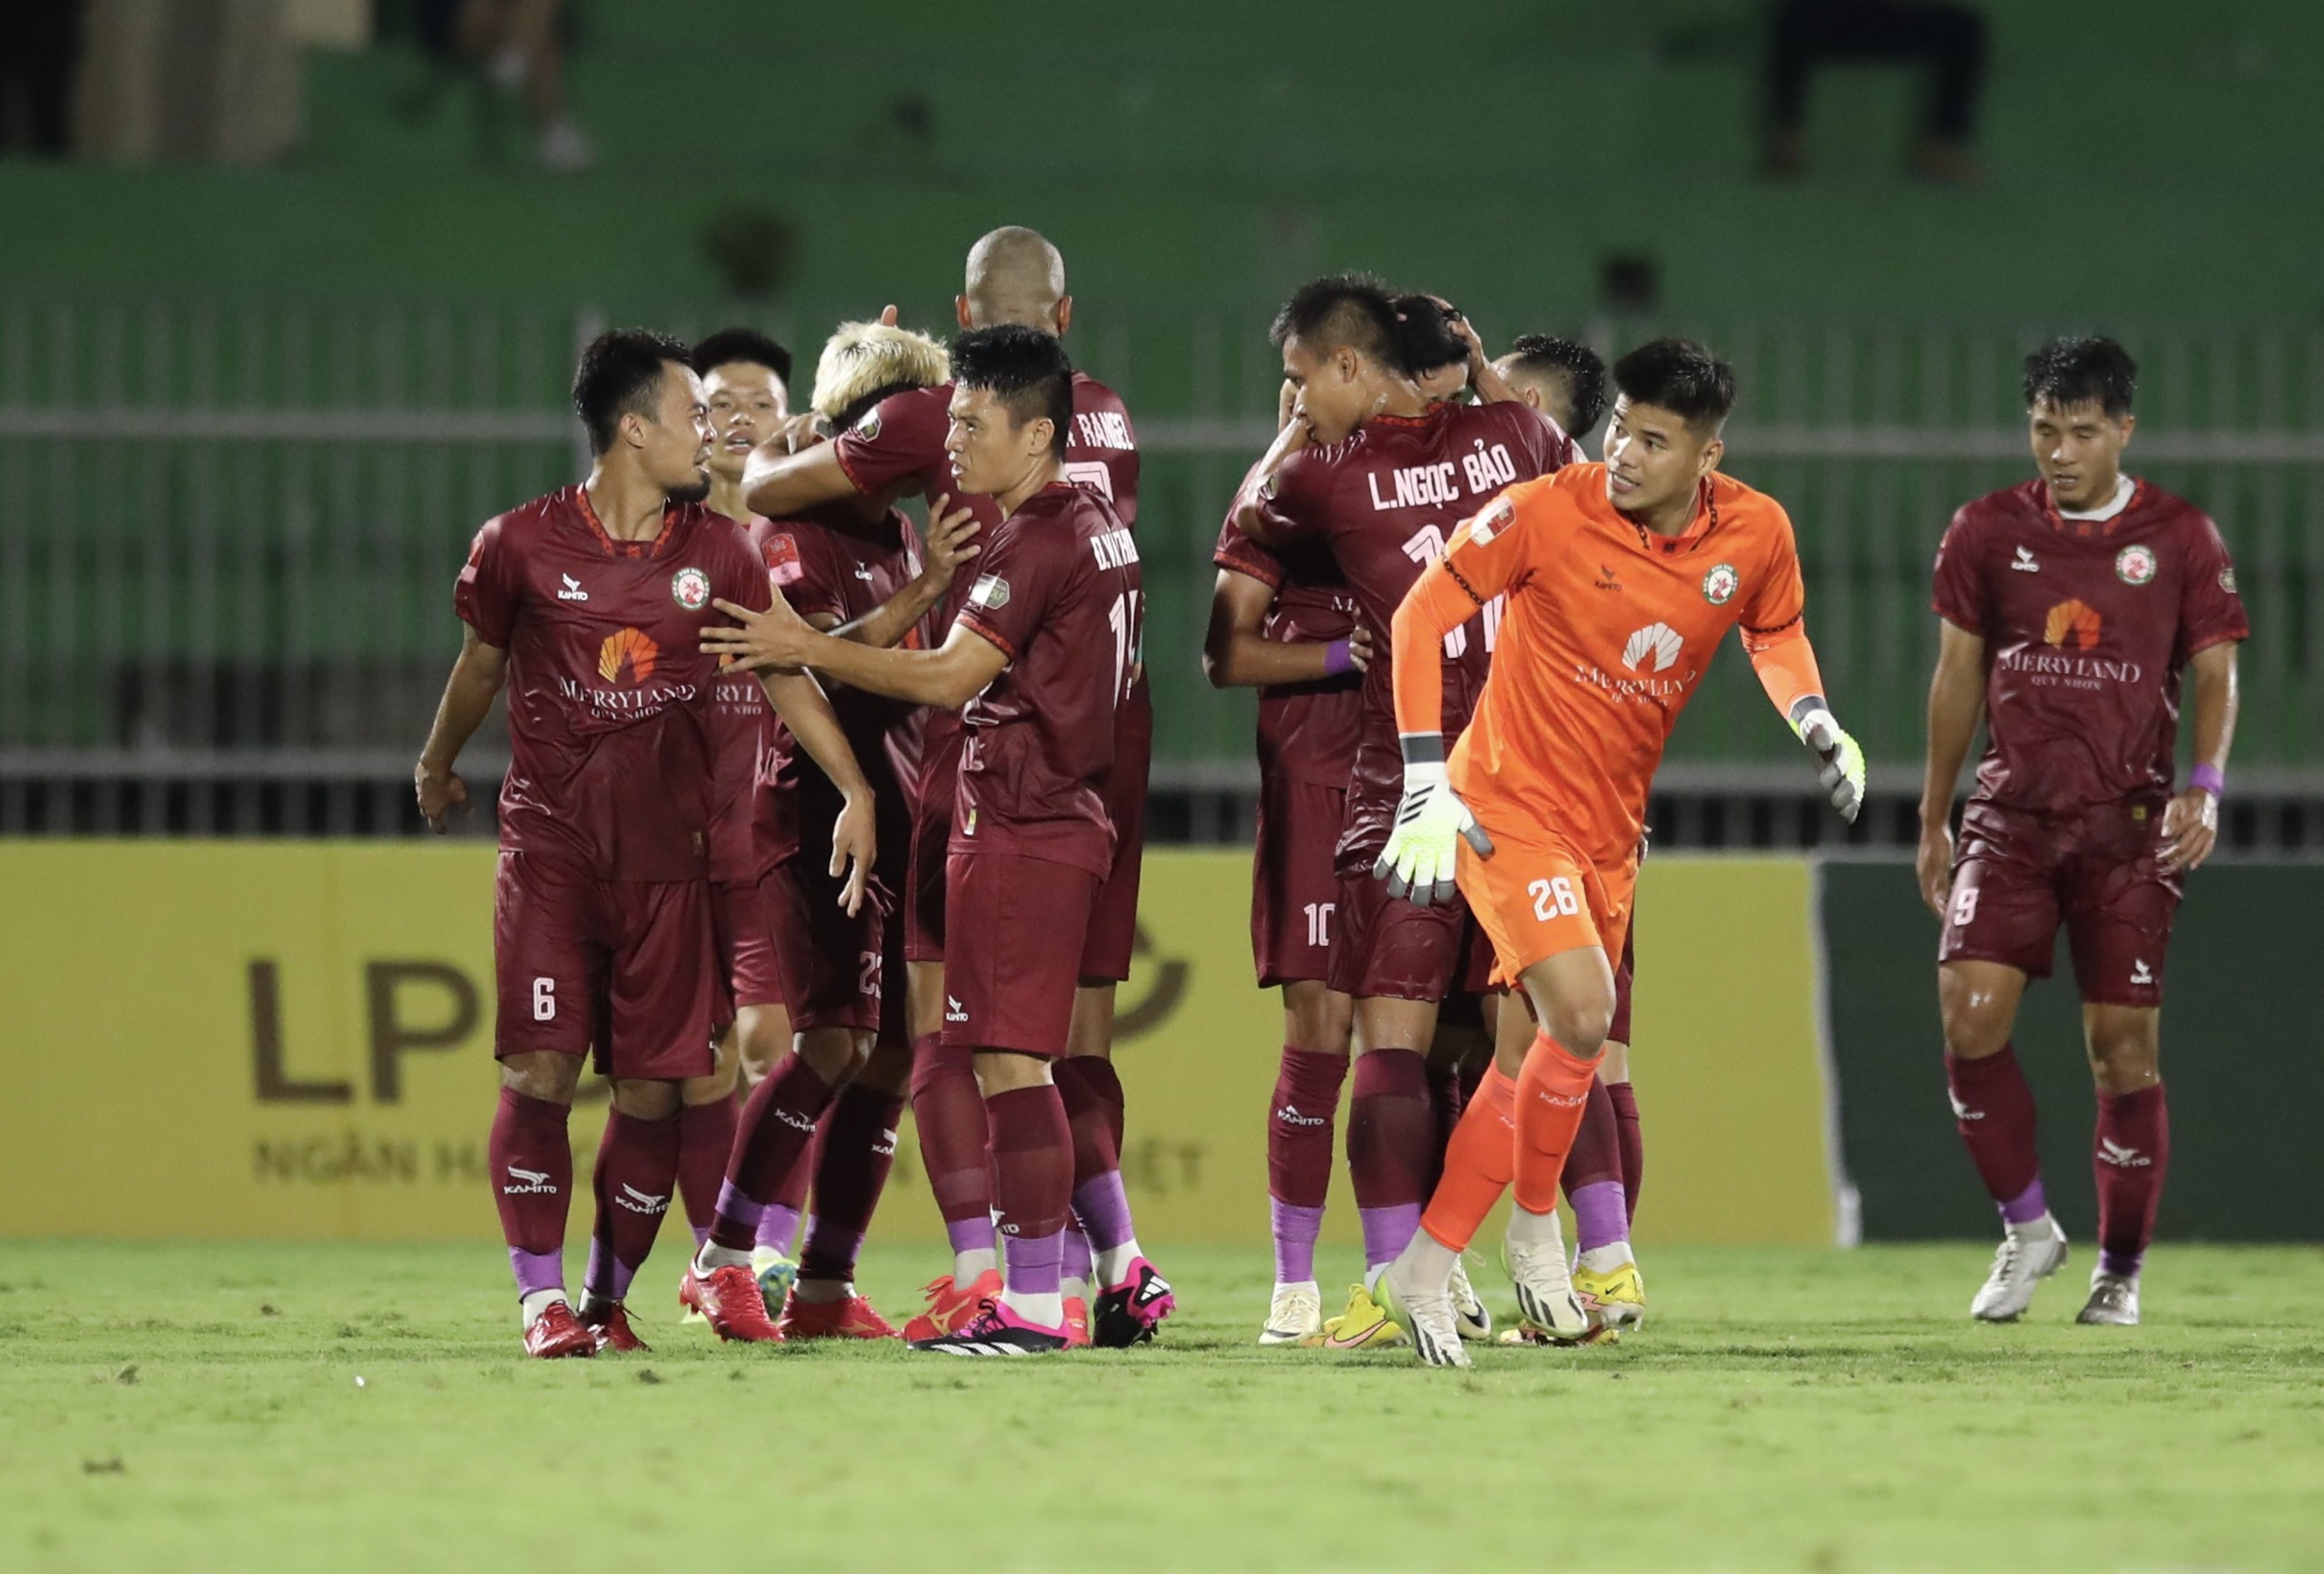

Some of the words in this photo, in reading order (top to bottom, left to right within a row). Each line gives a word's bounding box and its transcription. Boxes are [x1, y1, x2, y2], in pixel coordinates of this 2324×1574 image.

[1368, 461, 1459, 510] L.NGỌC
[1462, 439, 1516, 495] BẢO
[1527, 876, 1579, 922] 26
[1954, 888, 1980, 927] 9
[533, 977, 556, 1020] 6
[1277, 1109, 1325, 1126] KAMITO
[504, 1183, 558, 1195] KAMITO
[614, 1195, 670, 1215] KAMITO
